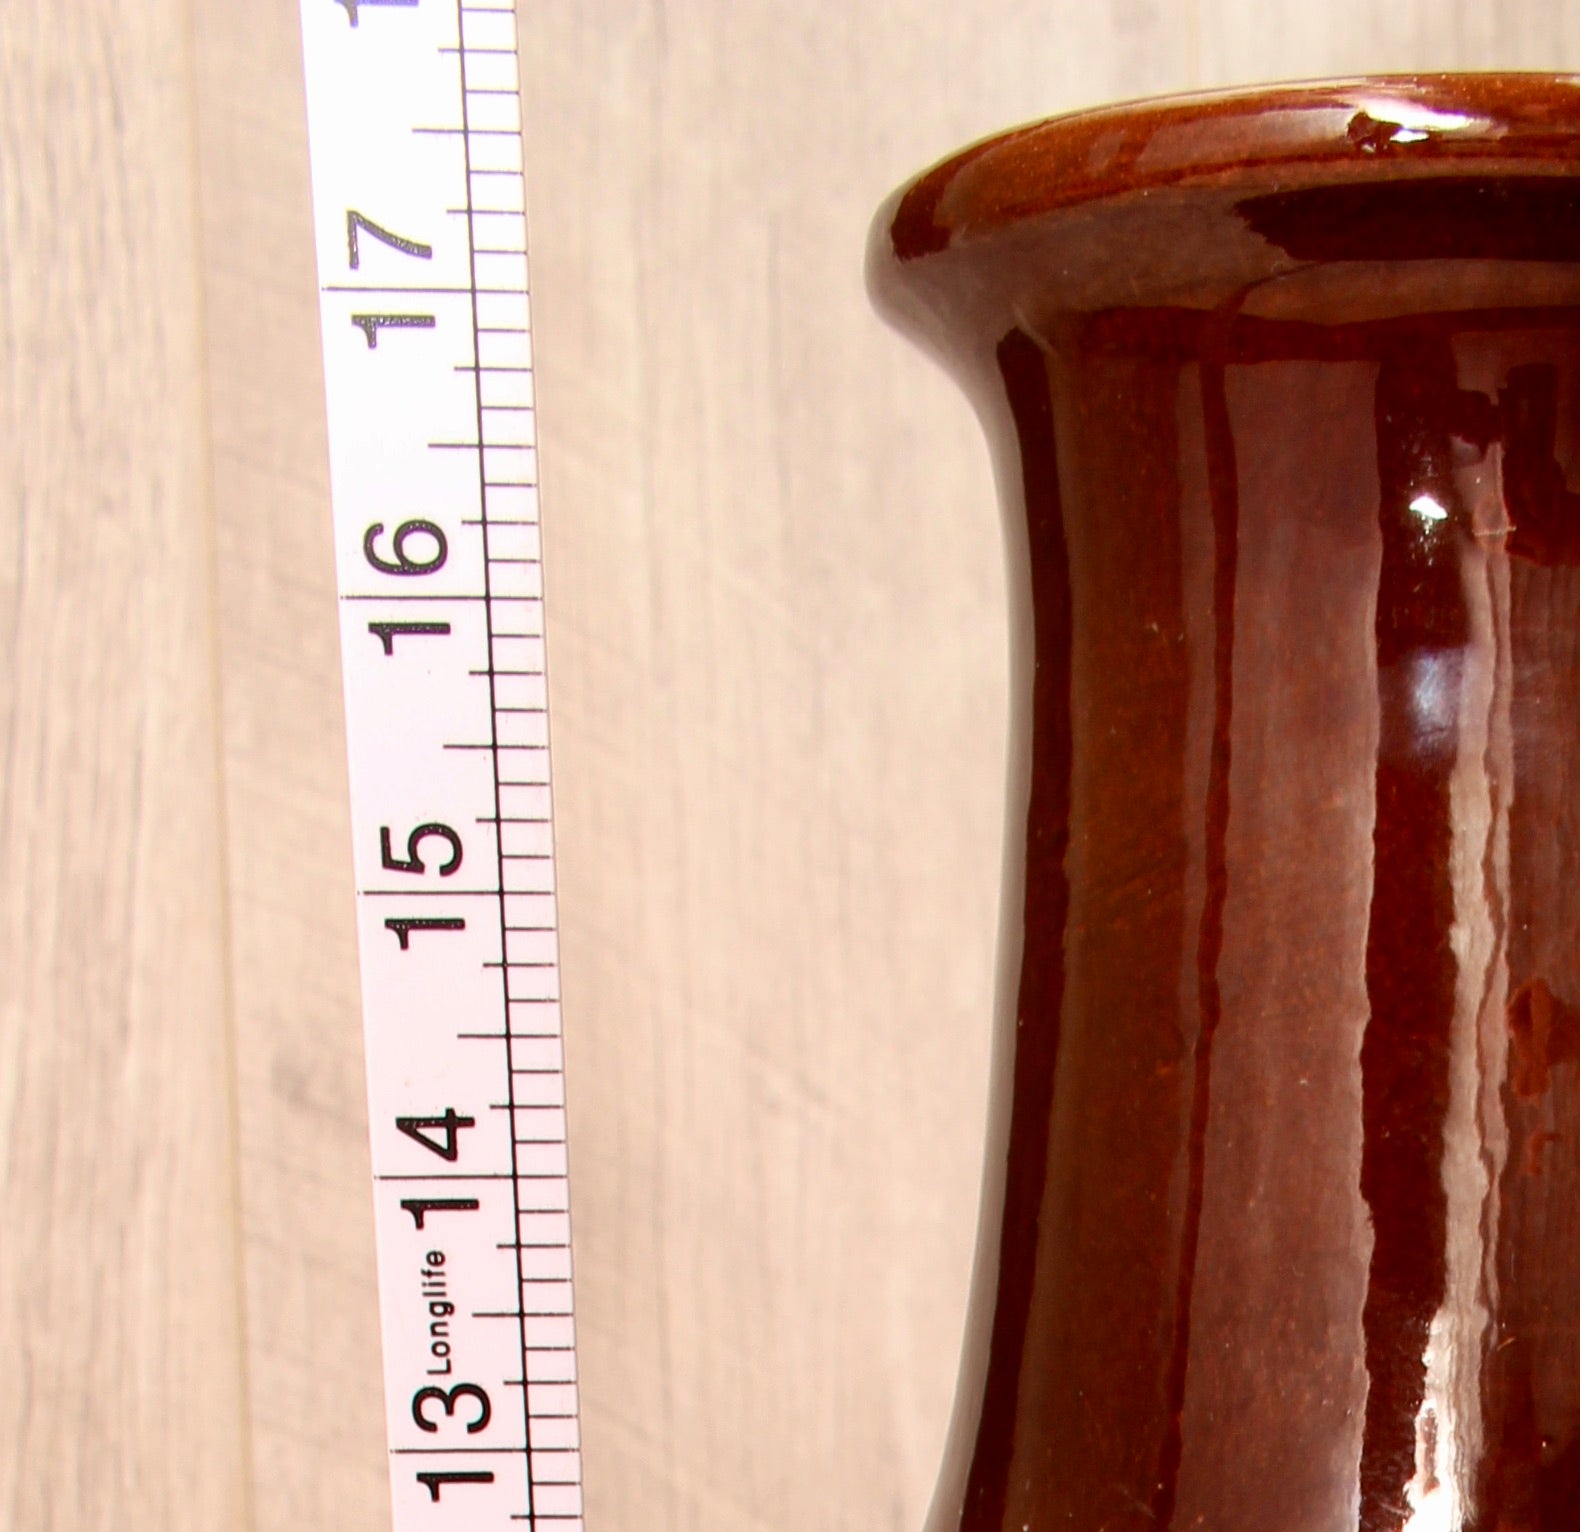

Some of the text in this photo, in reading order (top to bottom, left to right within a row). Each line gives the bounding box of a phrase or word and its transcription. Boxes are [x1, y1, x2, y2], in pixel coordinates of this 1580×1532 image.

[346, 210, 436, 349] 17
[363, 519, 451, 656] 16
[380, 822, 466, 951] 15
[395, 1106, 480, 1231] 14
[420, 1249, 455, 1376] Longlife
[411, 1382, 495, 1503] 13
